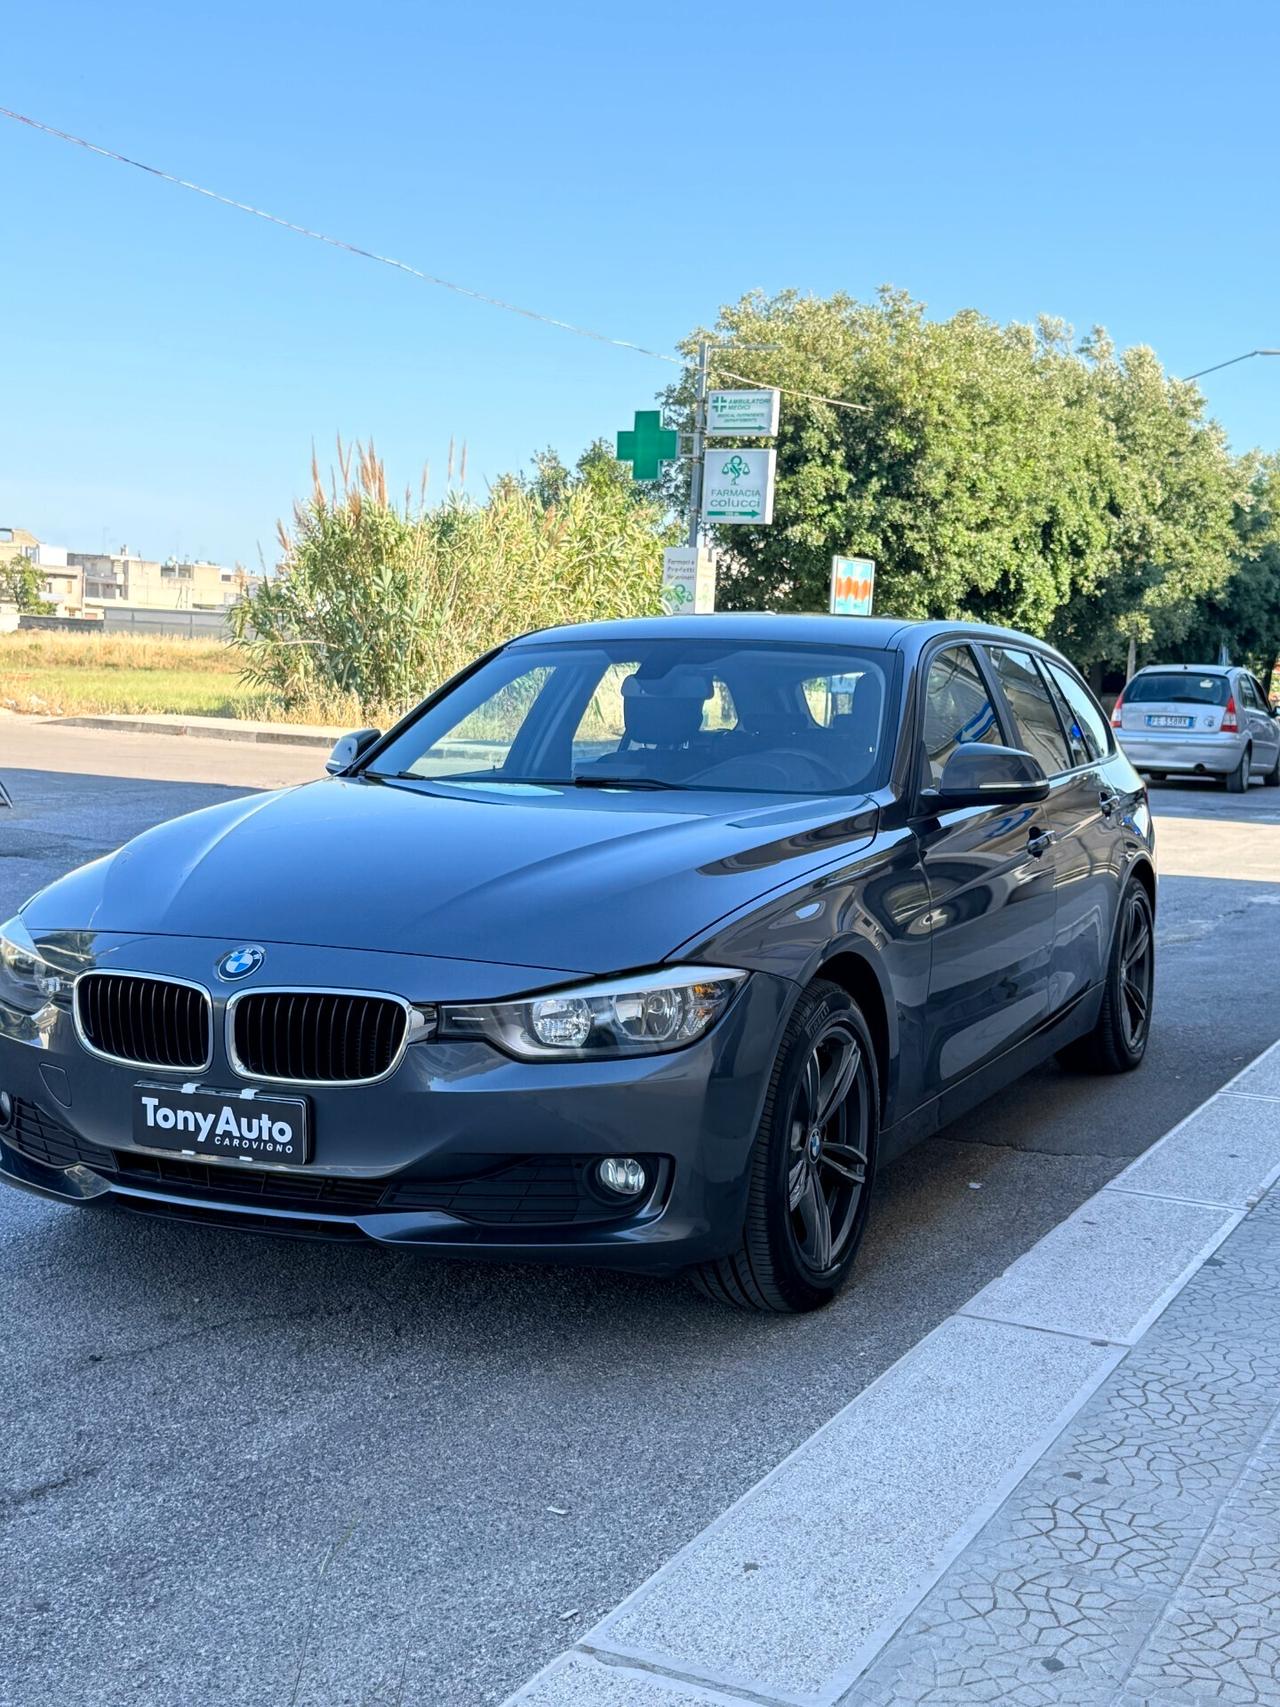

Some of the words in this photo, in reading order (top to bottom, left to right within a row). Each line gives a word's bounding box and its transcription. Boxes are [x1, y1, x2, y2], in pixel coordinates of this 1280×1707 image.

[711, 489, 761, 497] FARMACIA
[710, 498, 760, 508] colucci
[141, 1096, 293, 1143] TonyAuto
[214, 1136, 293, 1154] CAROVIGNO
